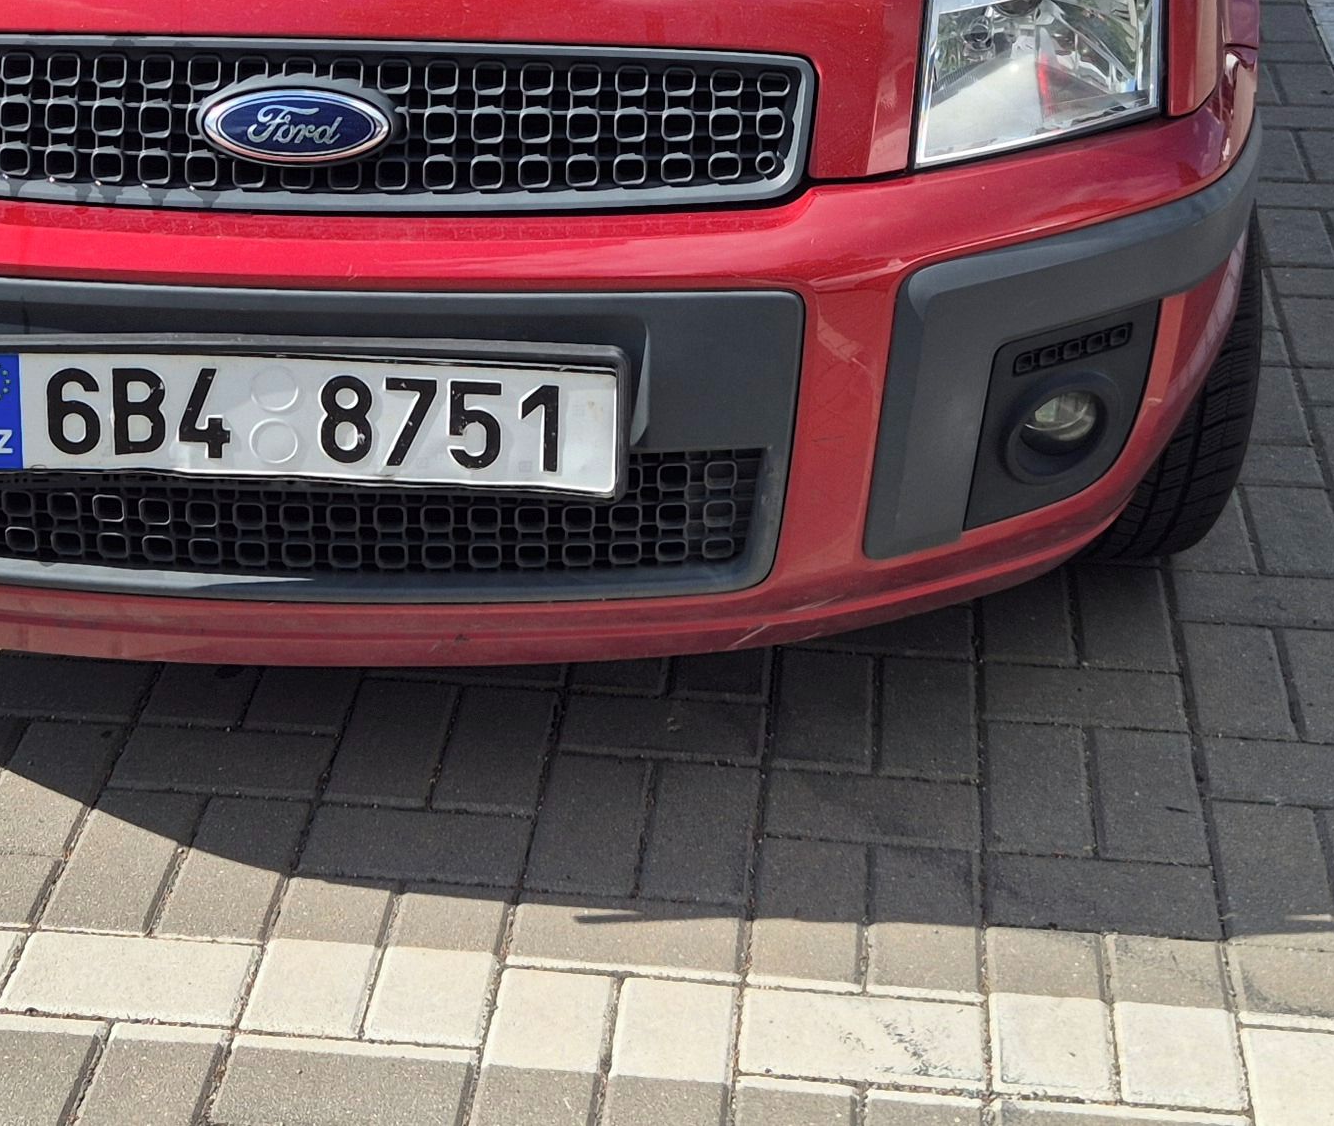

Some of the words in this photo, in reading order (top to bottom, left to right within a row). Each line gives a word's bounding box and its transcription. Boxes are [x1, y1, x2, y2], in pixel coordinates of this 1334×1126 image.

[247, 104, 343, 145] Ford
[46, 367, 231, 459] 6B4
[320, 375, 560, 472] 8751
